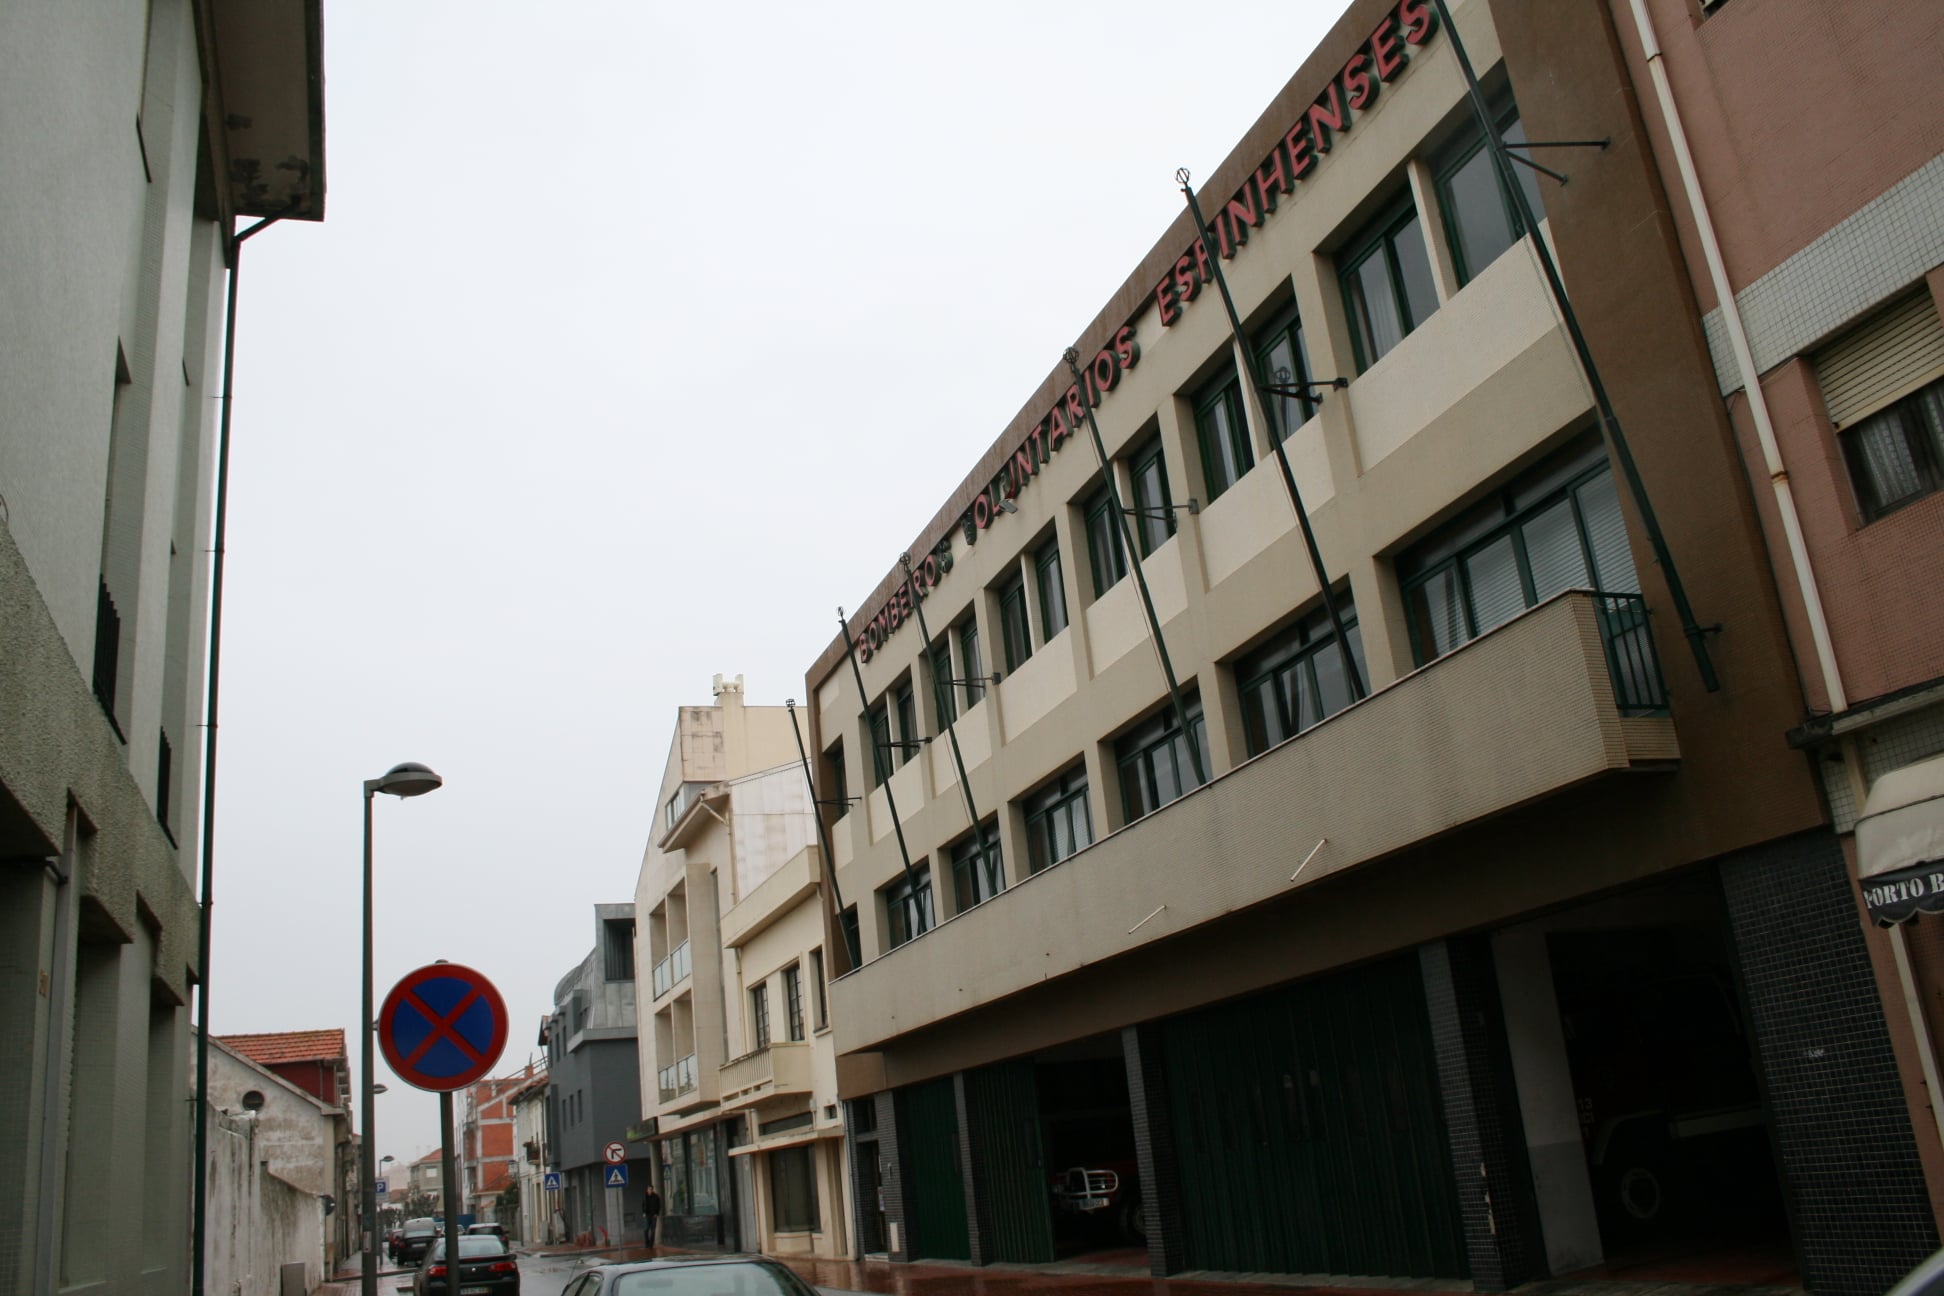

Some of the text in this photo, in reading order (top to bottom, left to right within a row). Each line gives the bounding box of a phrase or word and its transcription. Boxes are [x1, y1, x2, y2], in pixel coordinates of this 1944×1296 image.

[859, 0, 1440, 664] BOMBEIROS VOLUNTARIOS ESPINHENSES
